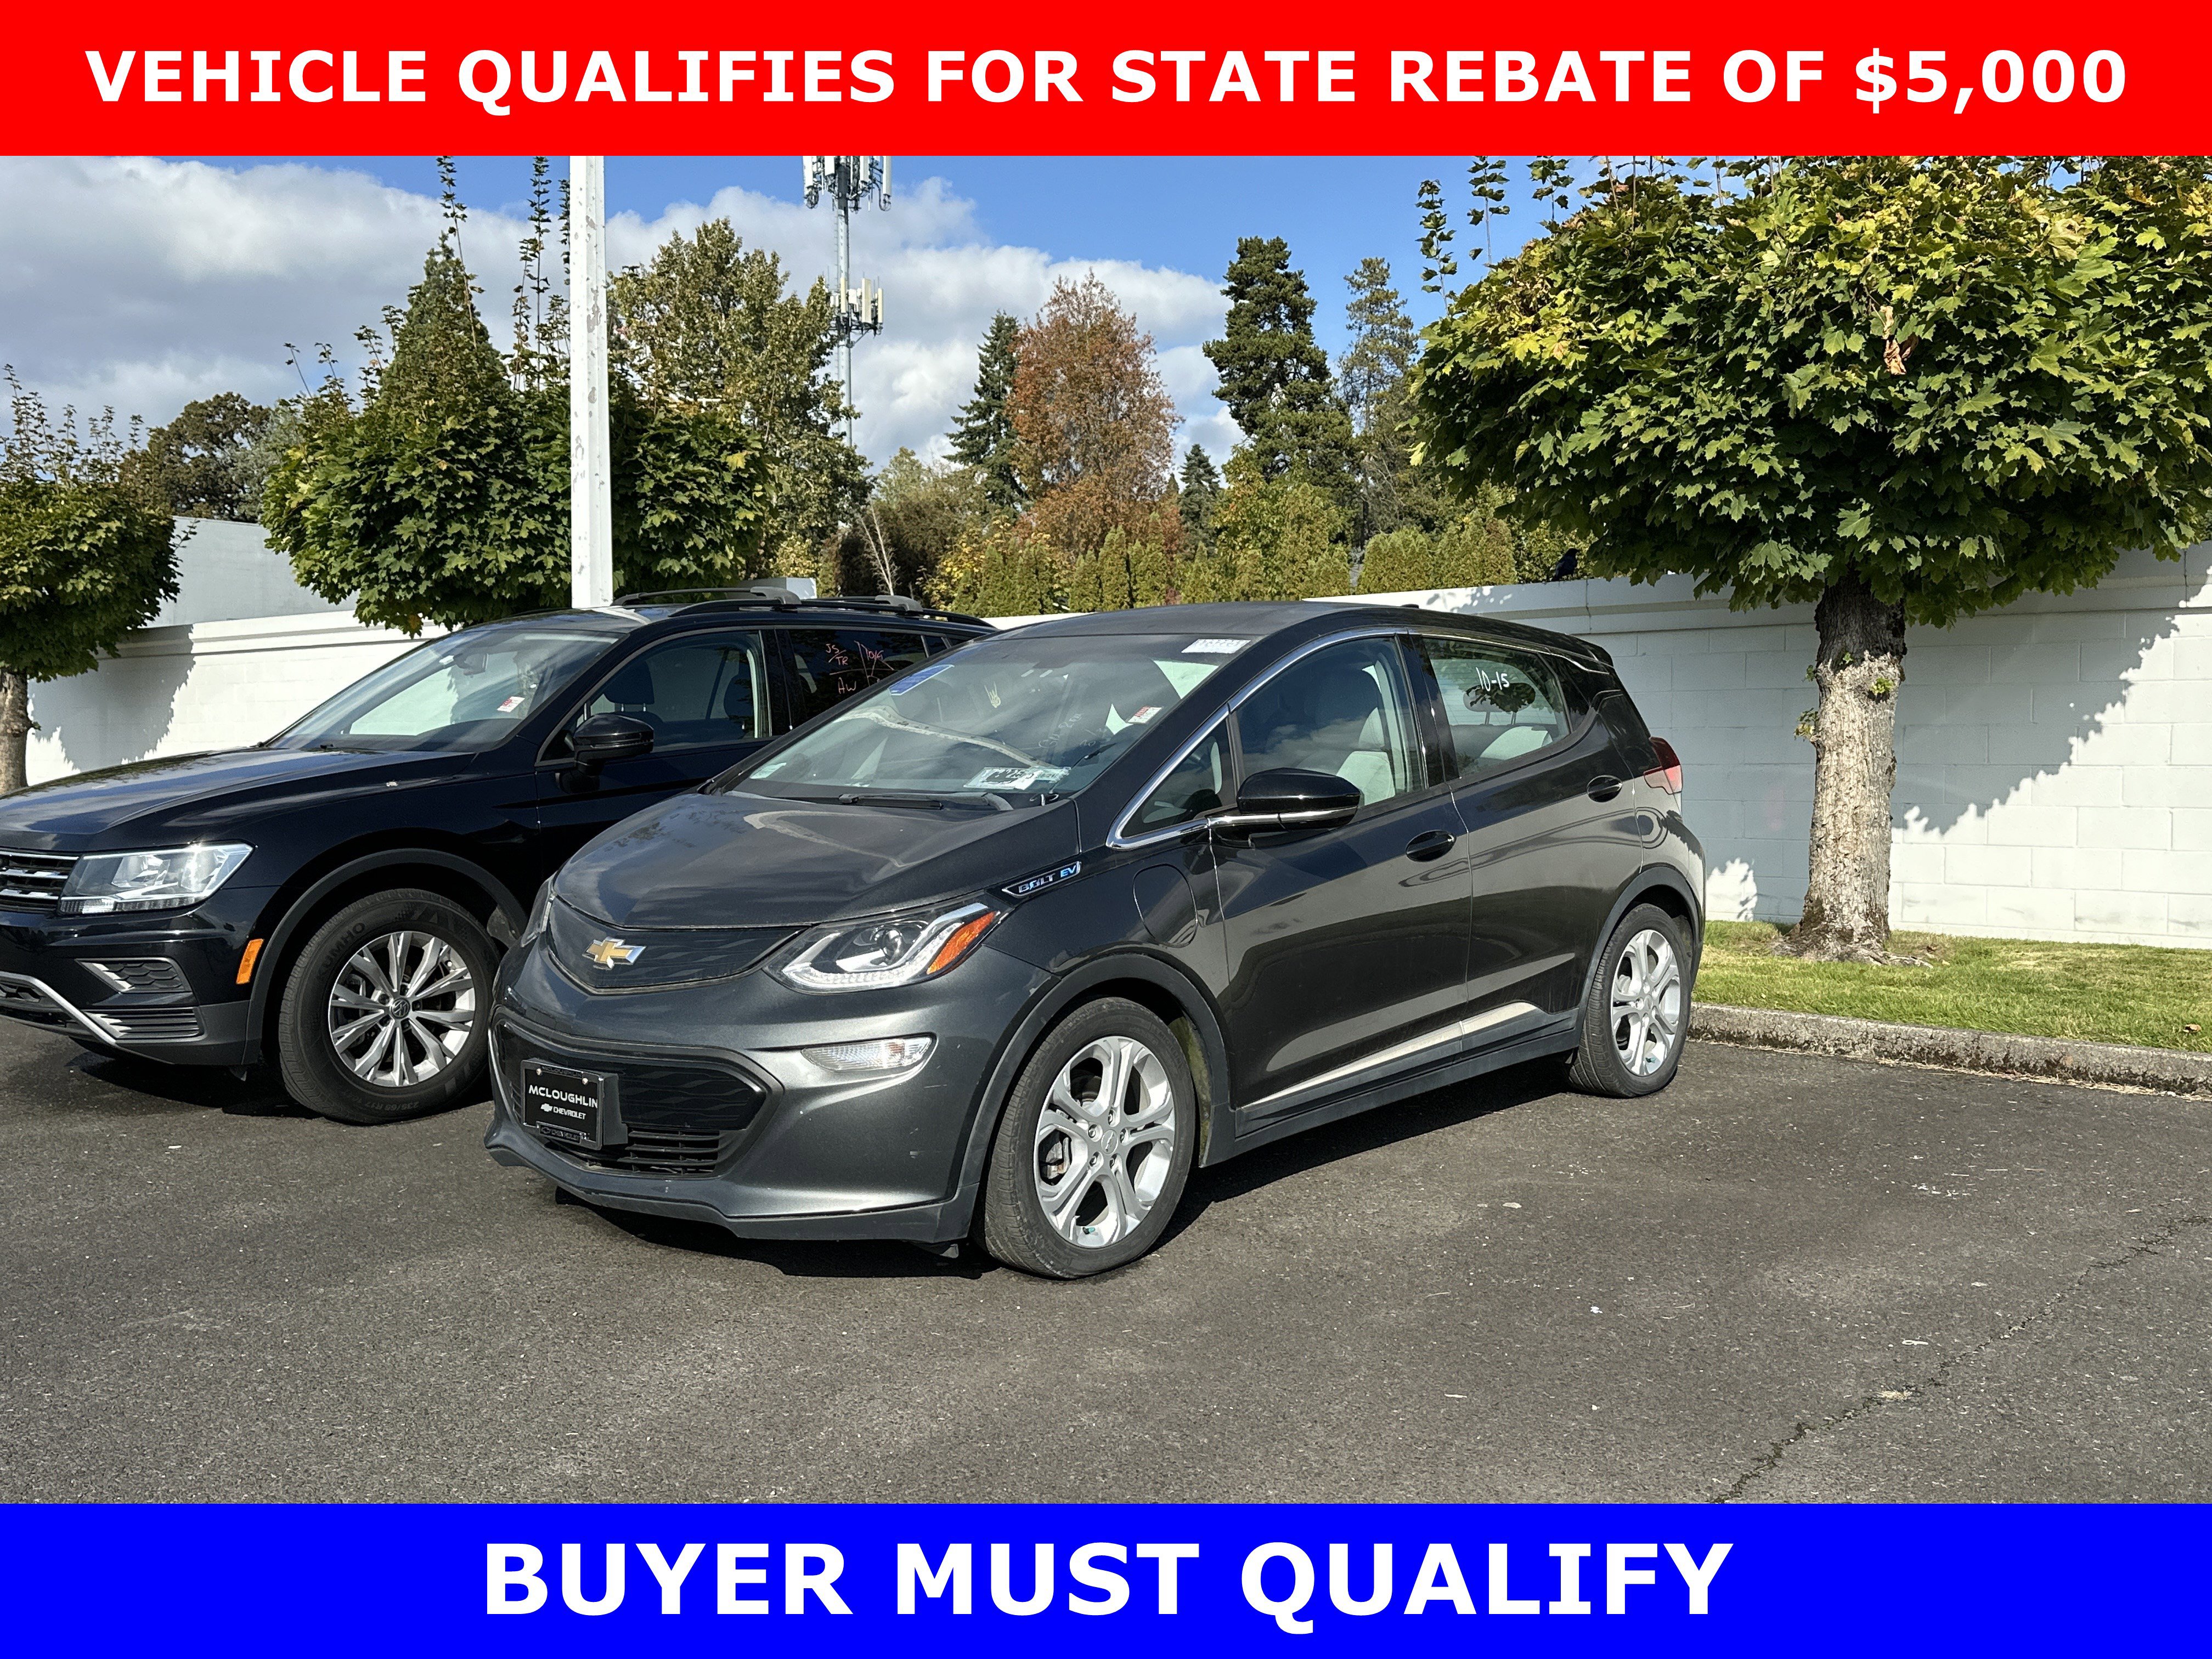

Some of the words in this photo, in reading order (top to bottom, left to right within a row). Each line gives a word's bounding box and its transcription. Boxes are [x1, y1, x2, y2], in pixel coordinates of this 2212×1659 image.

[1475, 667, 1510, 691] 10-15
[1018, 873, 1056, 893] BOLT
[1060, 865, 1076, 878] EV
[528, 1085, 599, 1108] MCLOUGHLIN
[553, 1105, 586, 1120] CHEVROLET
